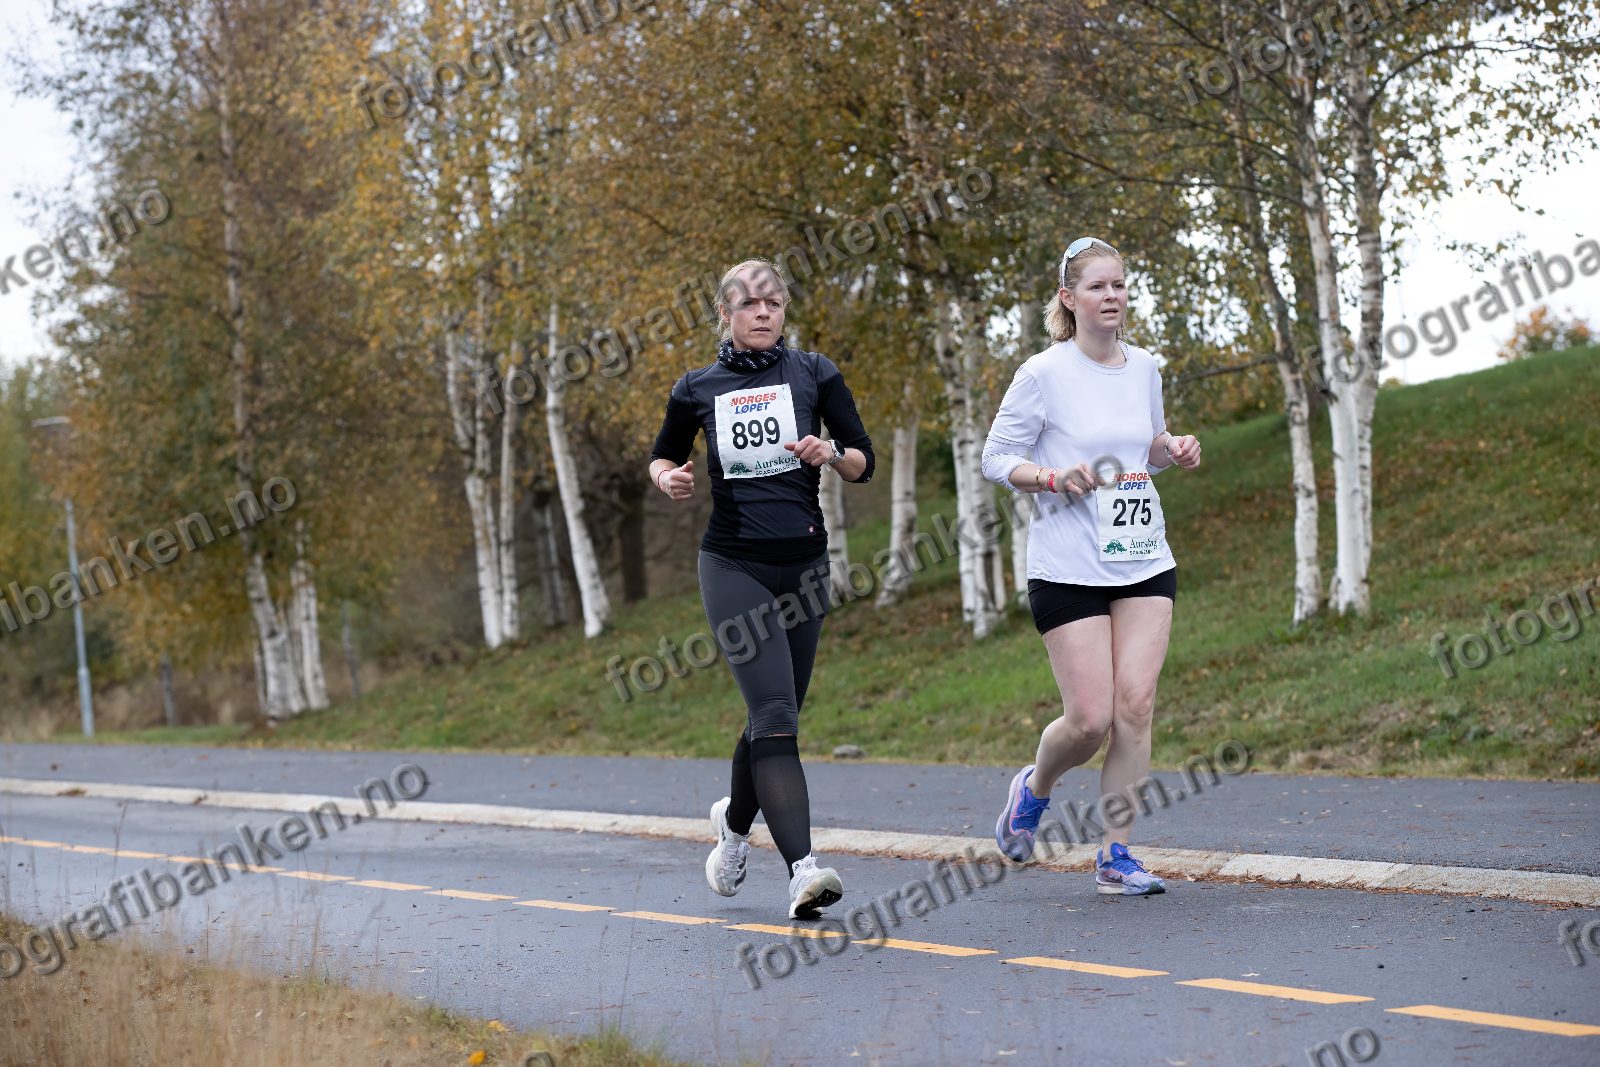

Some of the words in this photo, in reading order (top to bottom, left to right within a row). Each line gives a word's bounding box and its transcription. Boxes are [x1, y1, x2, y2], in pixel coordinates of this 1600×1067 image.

[731, 393, 777, 406] NORGES
[735, 402, 770, 414] LØPET
[732, 417, 780, 450] 899
[755, 456, 798, 470] Aurskog
[1118, 482, 1147, 490] LØPET
[1113, 499, 1152, 527] 275
